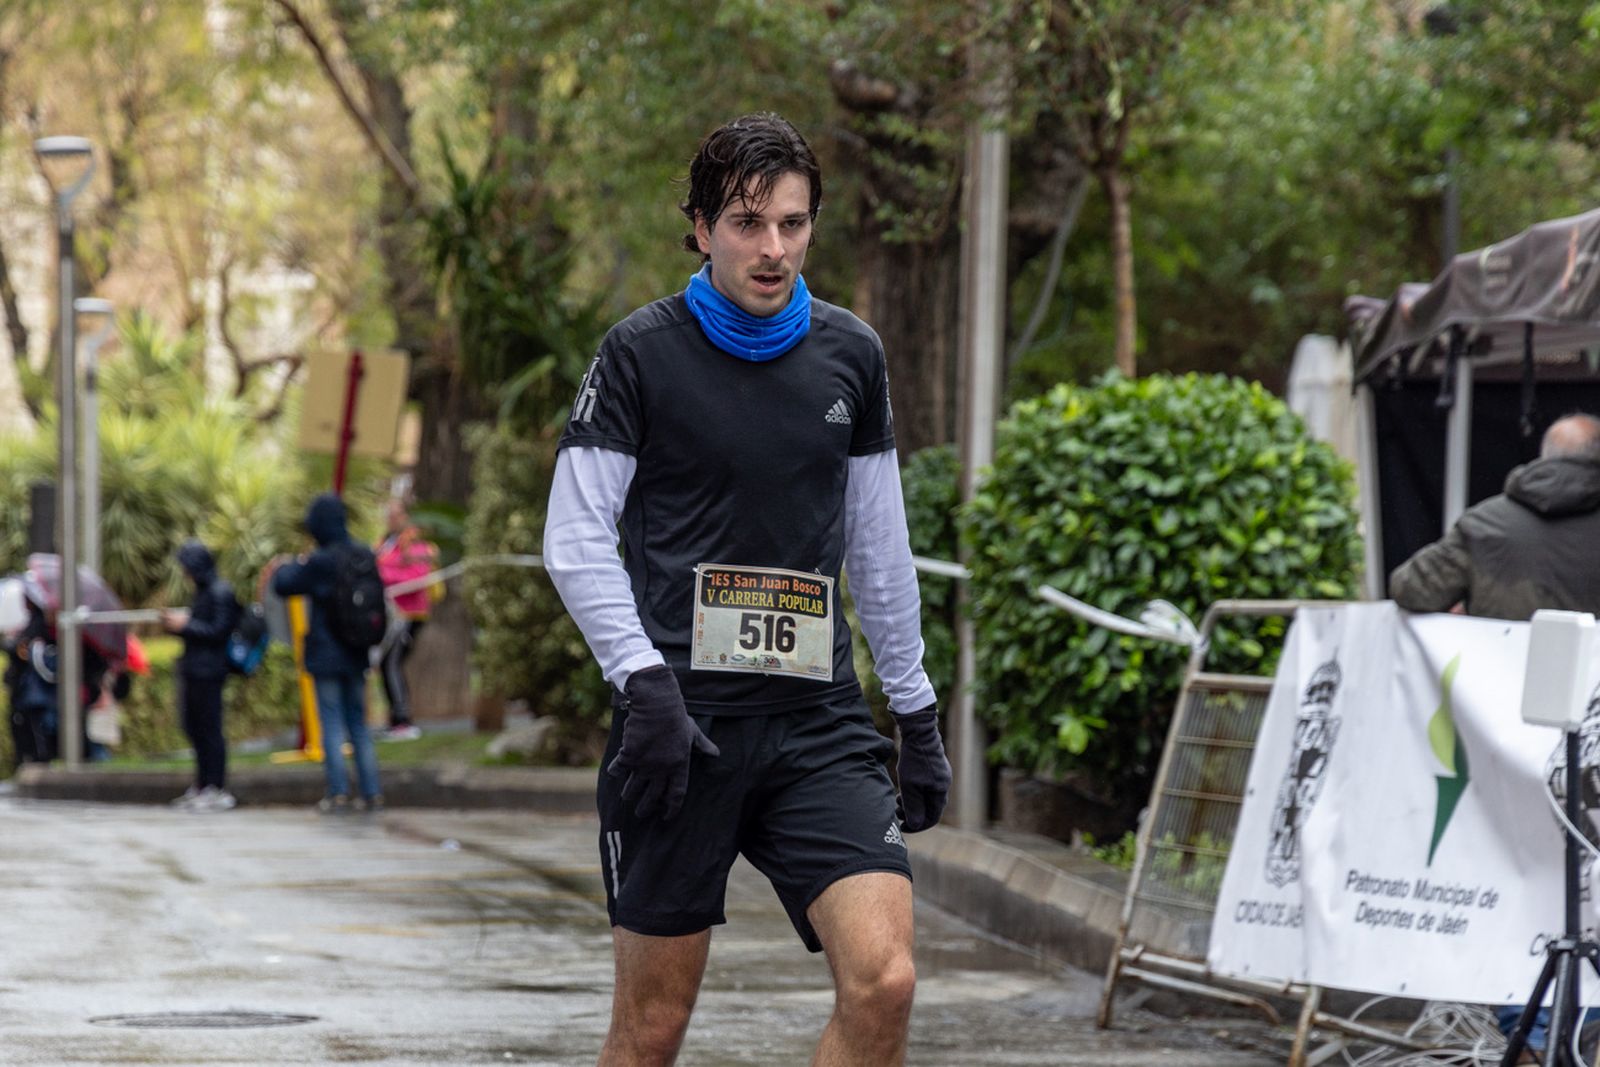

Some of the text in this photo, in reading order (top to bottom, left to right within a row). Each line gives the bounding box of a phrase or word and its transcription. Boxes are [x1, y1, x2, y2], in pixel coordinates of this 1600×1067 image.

[711, 573, 821, 595] IES San Juan Bosco
[707, 589, 824, 615] V CARRERA POPULAR
[739, 612, 796, 654] 516
[1345, 869, 1499, 909] Patronato Municipal de
[1355, 900, 1469, 935] Deportes de Jaén
